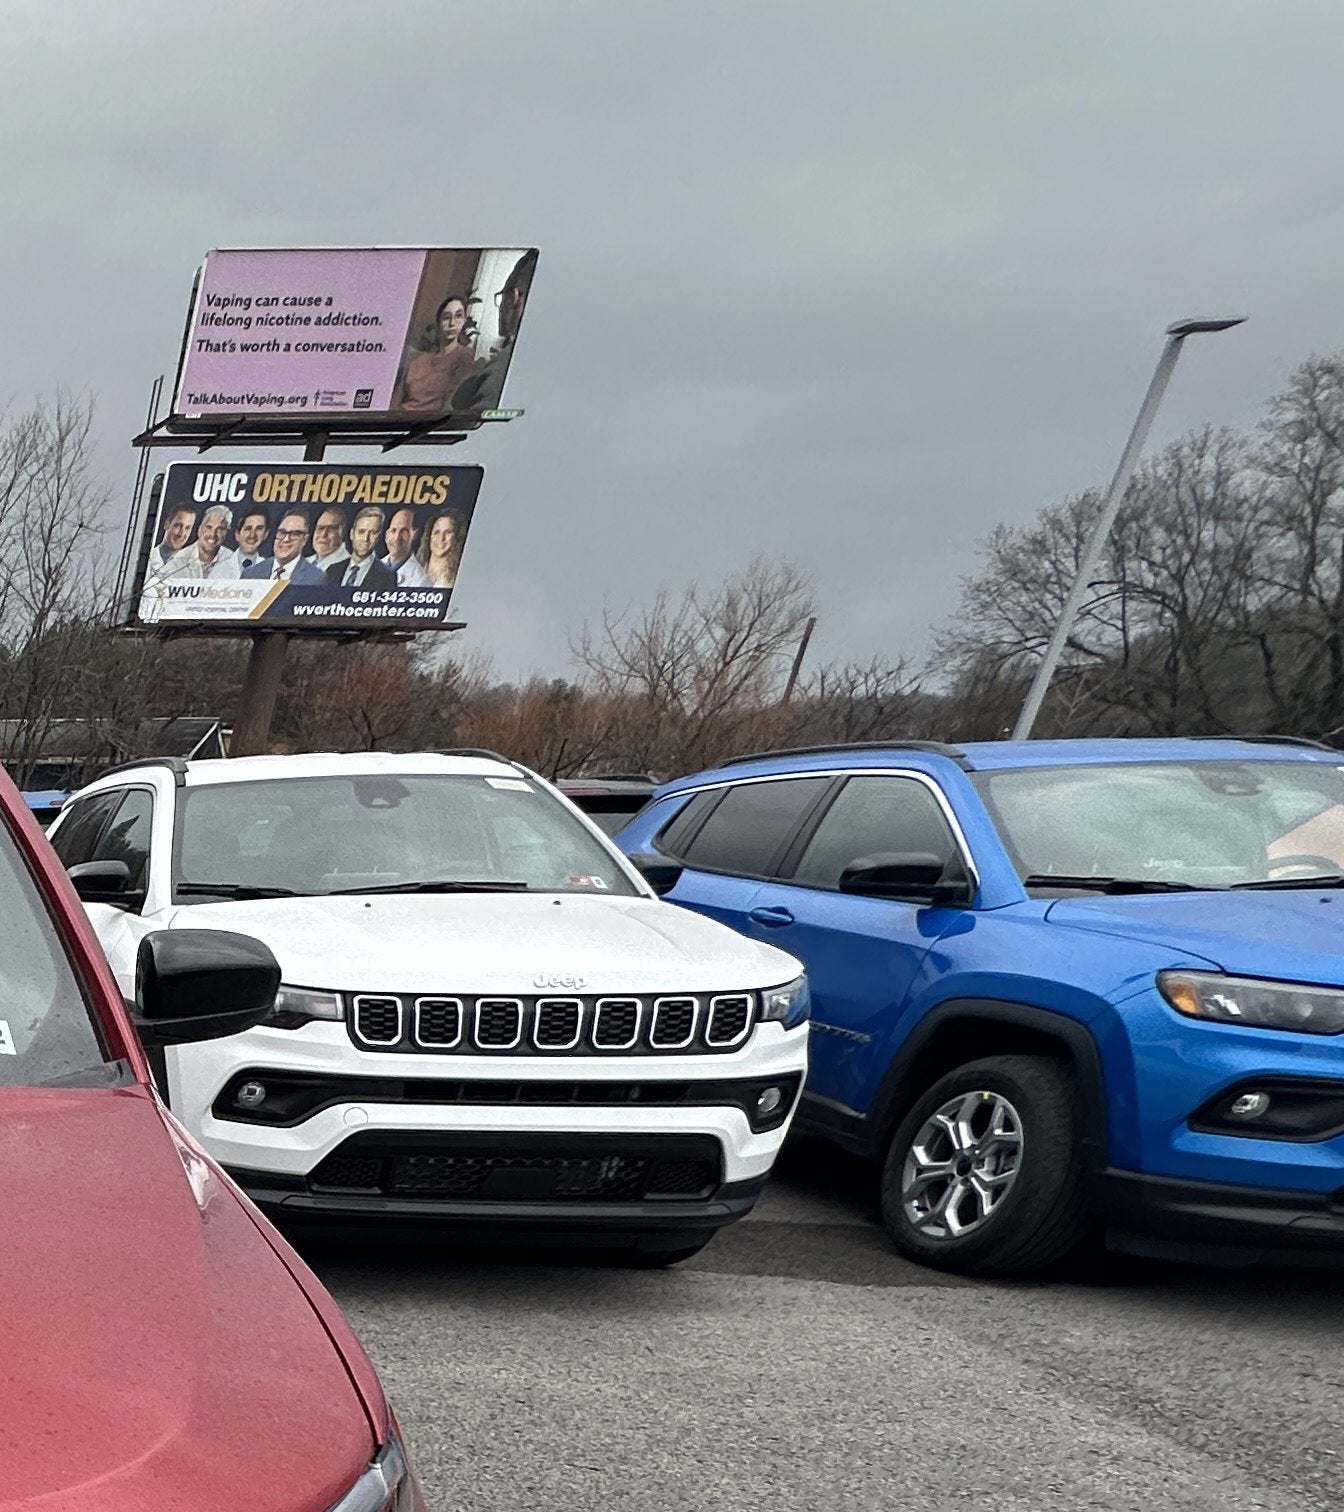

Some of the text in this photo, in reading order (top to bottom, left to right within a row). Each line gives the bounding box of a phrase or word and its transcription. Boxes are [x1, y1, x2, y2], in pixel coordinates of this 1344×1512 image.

[206, 293, 333, 311] Vaping can cause a
[200, 312, 383, 330] lifelong nicotine addiction.
[196, 339, 387, 353] That's worth a conversation.
[187, 393, 309, 407] TalkAboutVaping.org
[193, 473, 450, 505] UHC ORTHOPAEDICS
[352, 591, 444, 604] 681-342-3500
[293, 603, 440, 618] wvorthocenter.com
